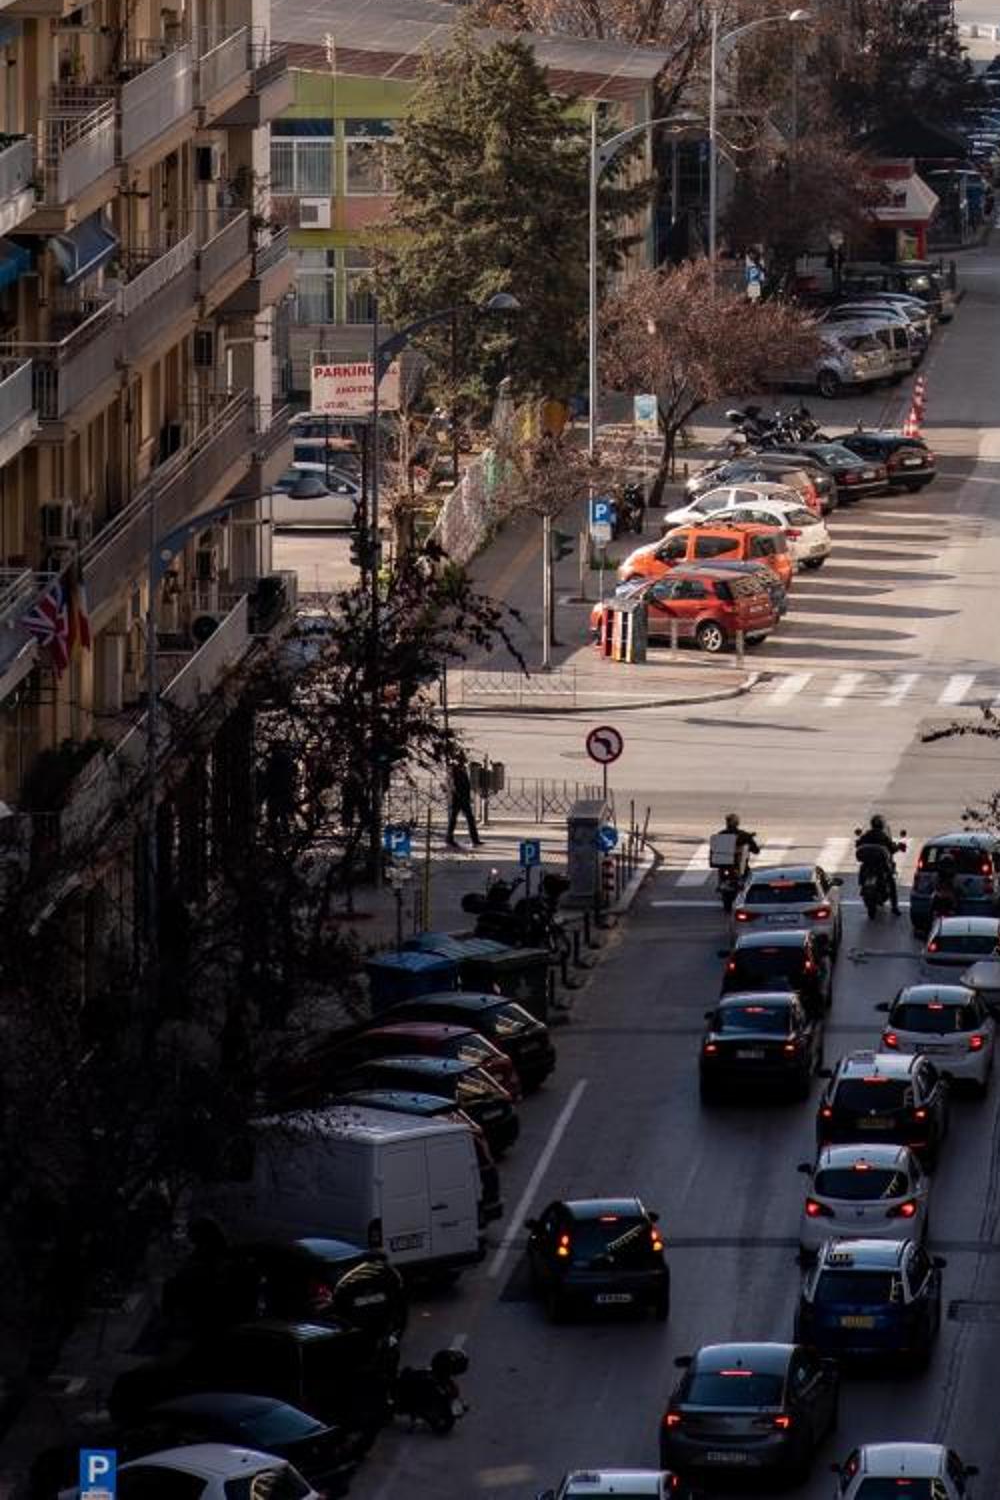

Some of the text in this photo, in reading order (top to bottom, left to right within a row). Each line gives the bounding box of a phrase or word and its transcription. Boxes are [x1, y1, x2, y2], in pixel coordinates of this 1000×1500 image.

[596, 504, 607, 518] P
[391, 831, 405, 850] P
[88, 1455, 109, 1483] P
